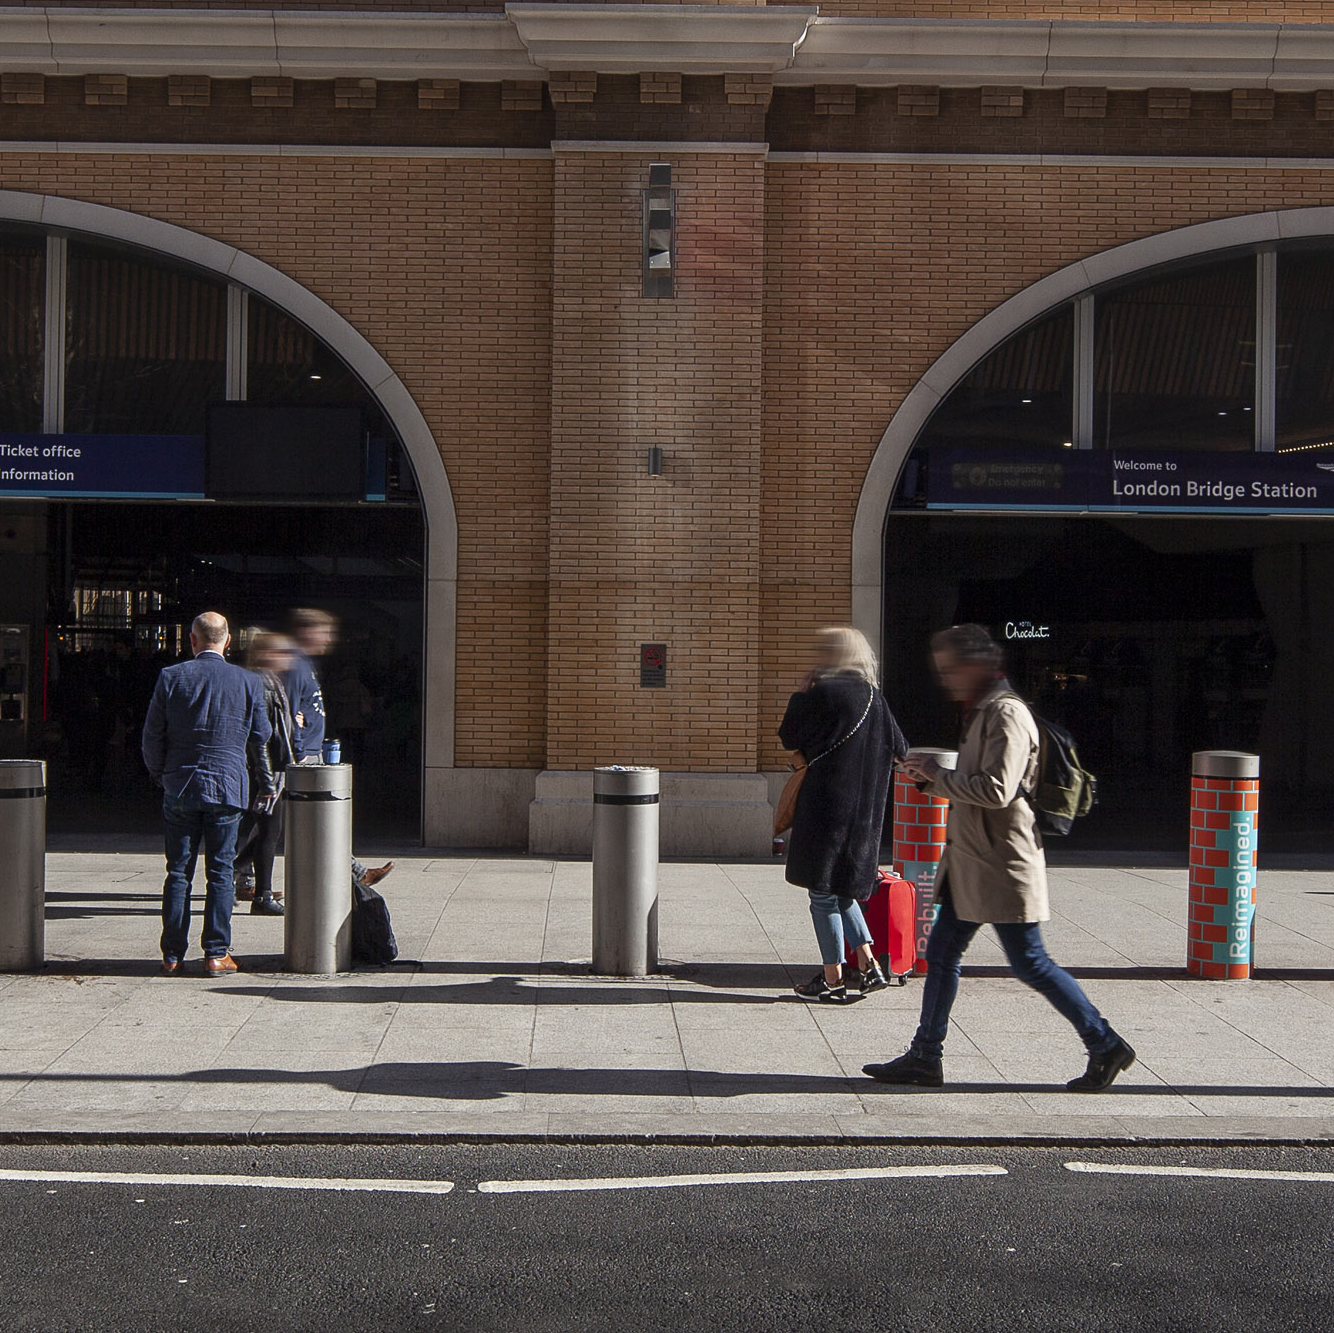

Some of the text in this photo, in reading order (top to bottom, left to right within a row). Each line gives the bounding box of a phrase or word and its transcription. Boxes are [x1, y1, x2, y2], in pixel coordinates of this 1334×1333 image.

[42, 445, 82, 458] office
[1113, 460, 1177, 471] Welcome to
[1113, 480, 1317, 501] London Bridge Station
[1229, 817, 1252, 958] Reimagined.
